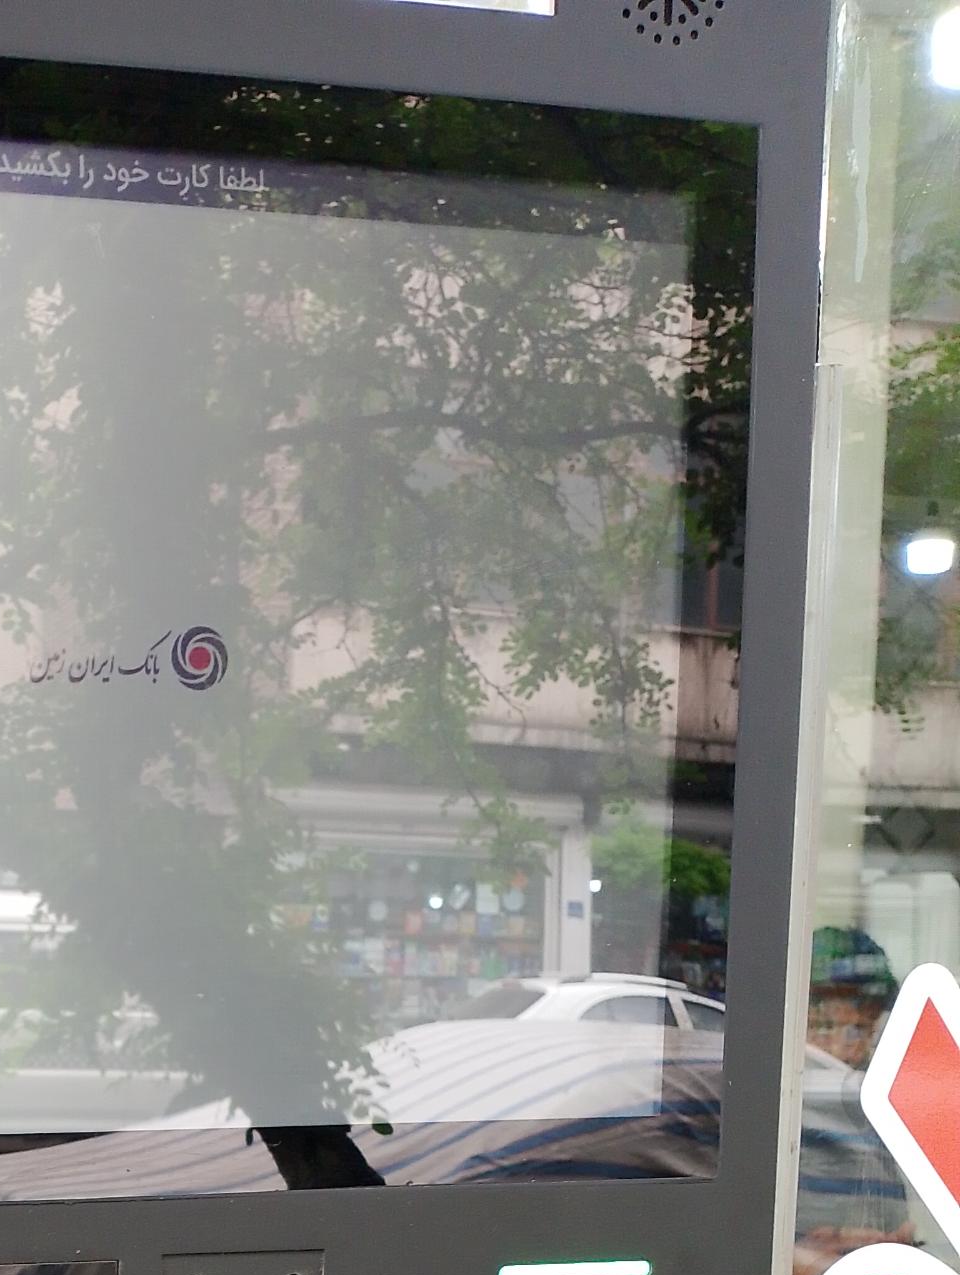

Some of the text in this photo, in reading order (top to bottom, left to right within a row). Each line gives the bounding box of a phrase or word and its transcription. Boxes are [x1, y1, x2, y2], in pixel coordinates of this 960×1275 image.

[78, 154, 94, 189] را
[102, 159, 150, 193] خود
[156, 163, 211, 196] کارت
[29, 630, 172, 684] بانک ایران زمین
